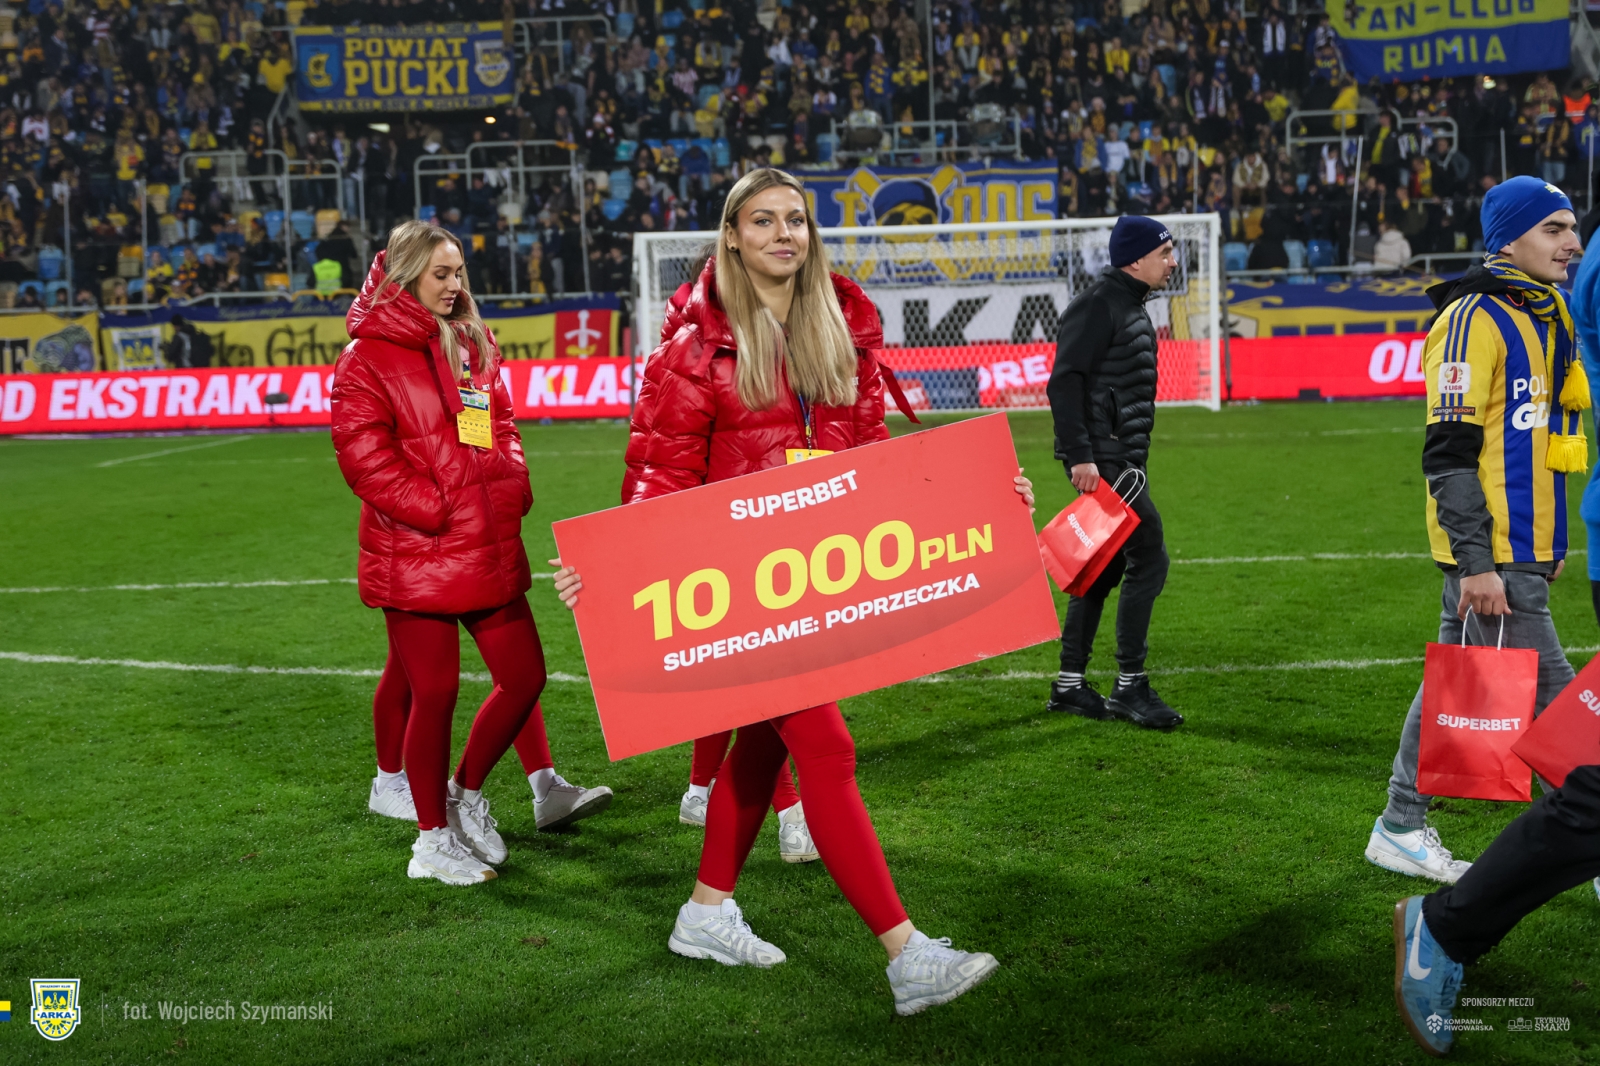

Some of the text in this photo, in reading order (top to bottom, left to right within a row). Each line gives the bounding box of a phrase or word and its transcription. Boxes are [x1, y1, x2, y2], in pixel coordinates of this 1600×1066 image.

[344, 37, 468, 58] POWIAT
[1384, 34, 1506, 73] RUMIA
[343, 58, 469, 96] PUCKI
[877, 293, 1063, 348] KA
[0, 380, 37, 422] D
[1513, 374, 1549, 400] POL
[730, 469, 858, 521] SUPERBET
[1067, 513, 1095, 550] SUPERBET
[633, 520, 994, 641] 10 000 PLN
[663, 572, 981, 671] SUPERGAME: POPRZECZKA
[1437, 713, 1522, 731] SUPERBET
[1579, 689, 1600, 717] SU
